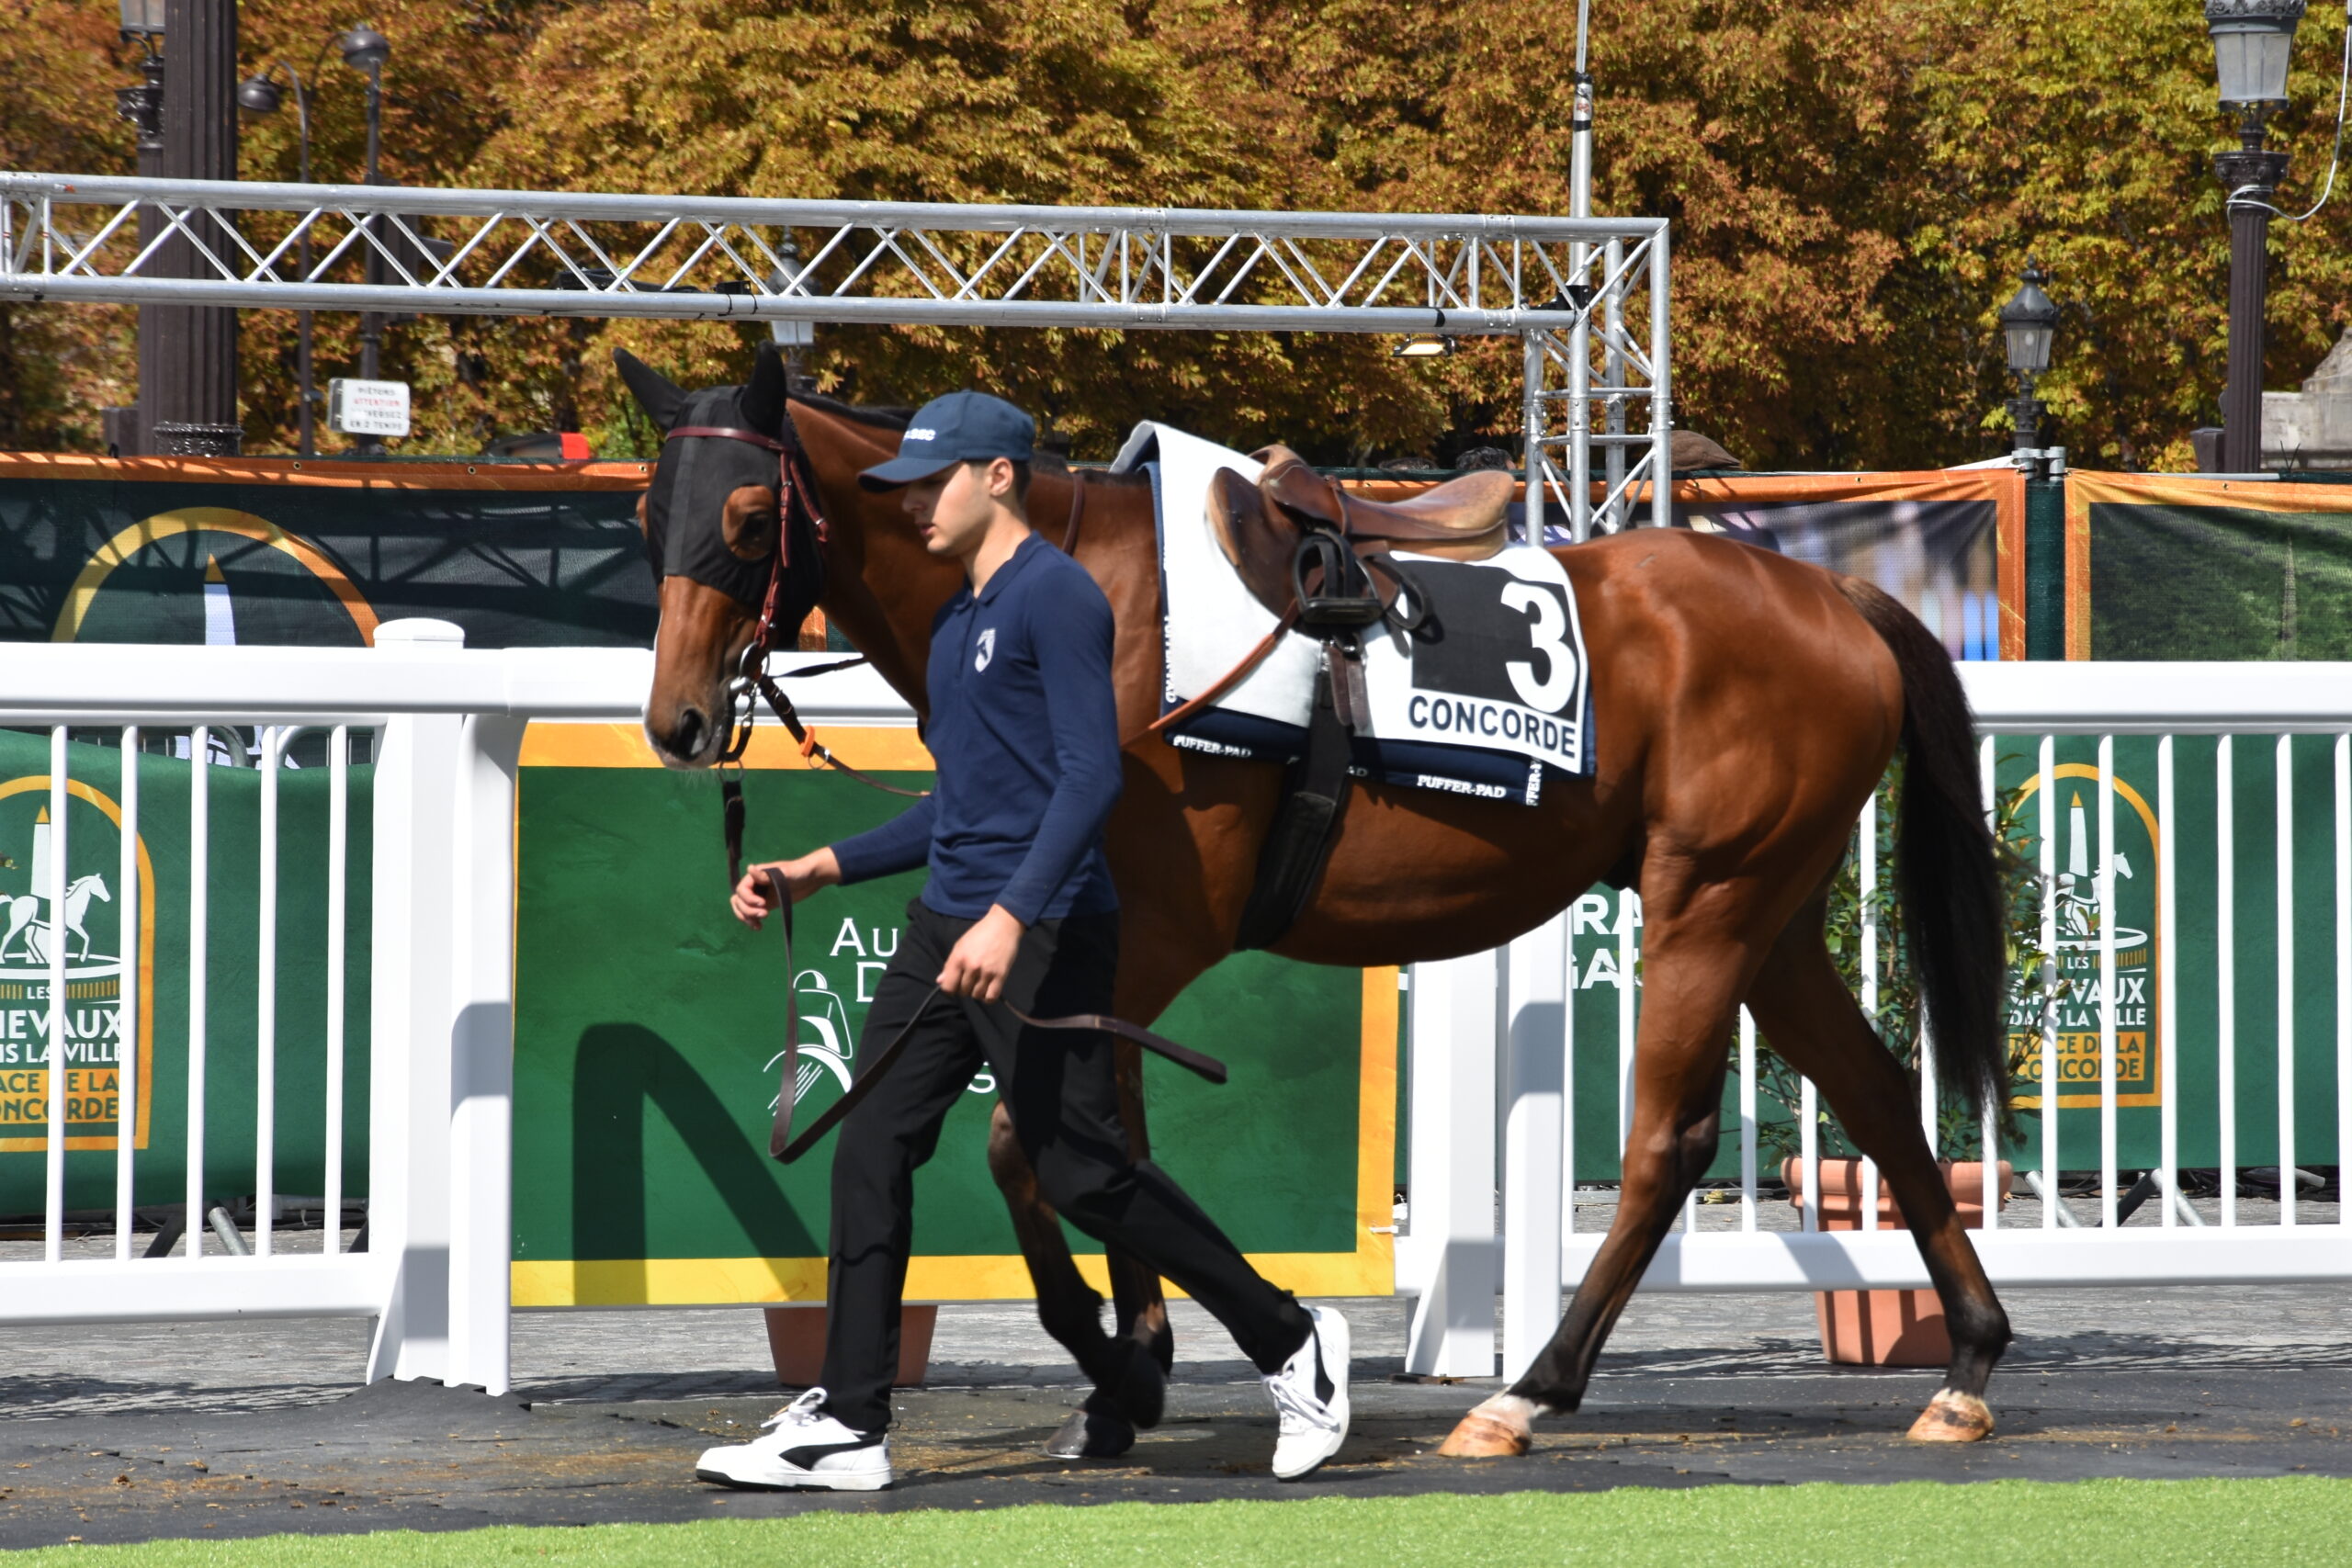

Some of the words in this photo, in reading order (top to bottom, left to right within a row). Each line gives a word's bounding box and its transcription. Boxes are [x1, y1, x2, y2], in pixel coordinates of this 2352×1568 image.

[1500, 581, 1577, 714] 3
[1408, 695, 1576, 759] CONCORDE
[1172, 734, 1252, 758] PUFFER-PAD
[1417, 773, 1507, 798] PUFFER-PAD
[2067, 956, 2089, 970] LES
[2066, 1008, 2091, 1027] LA
[88, 1072, 119, 1092] LA
